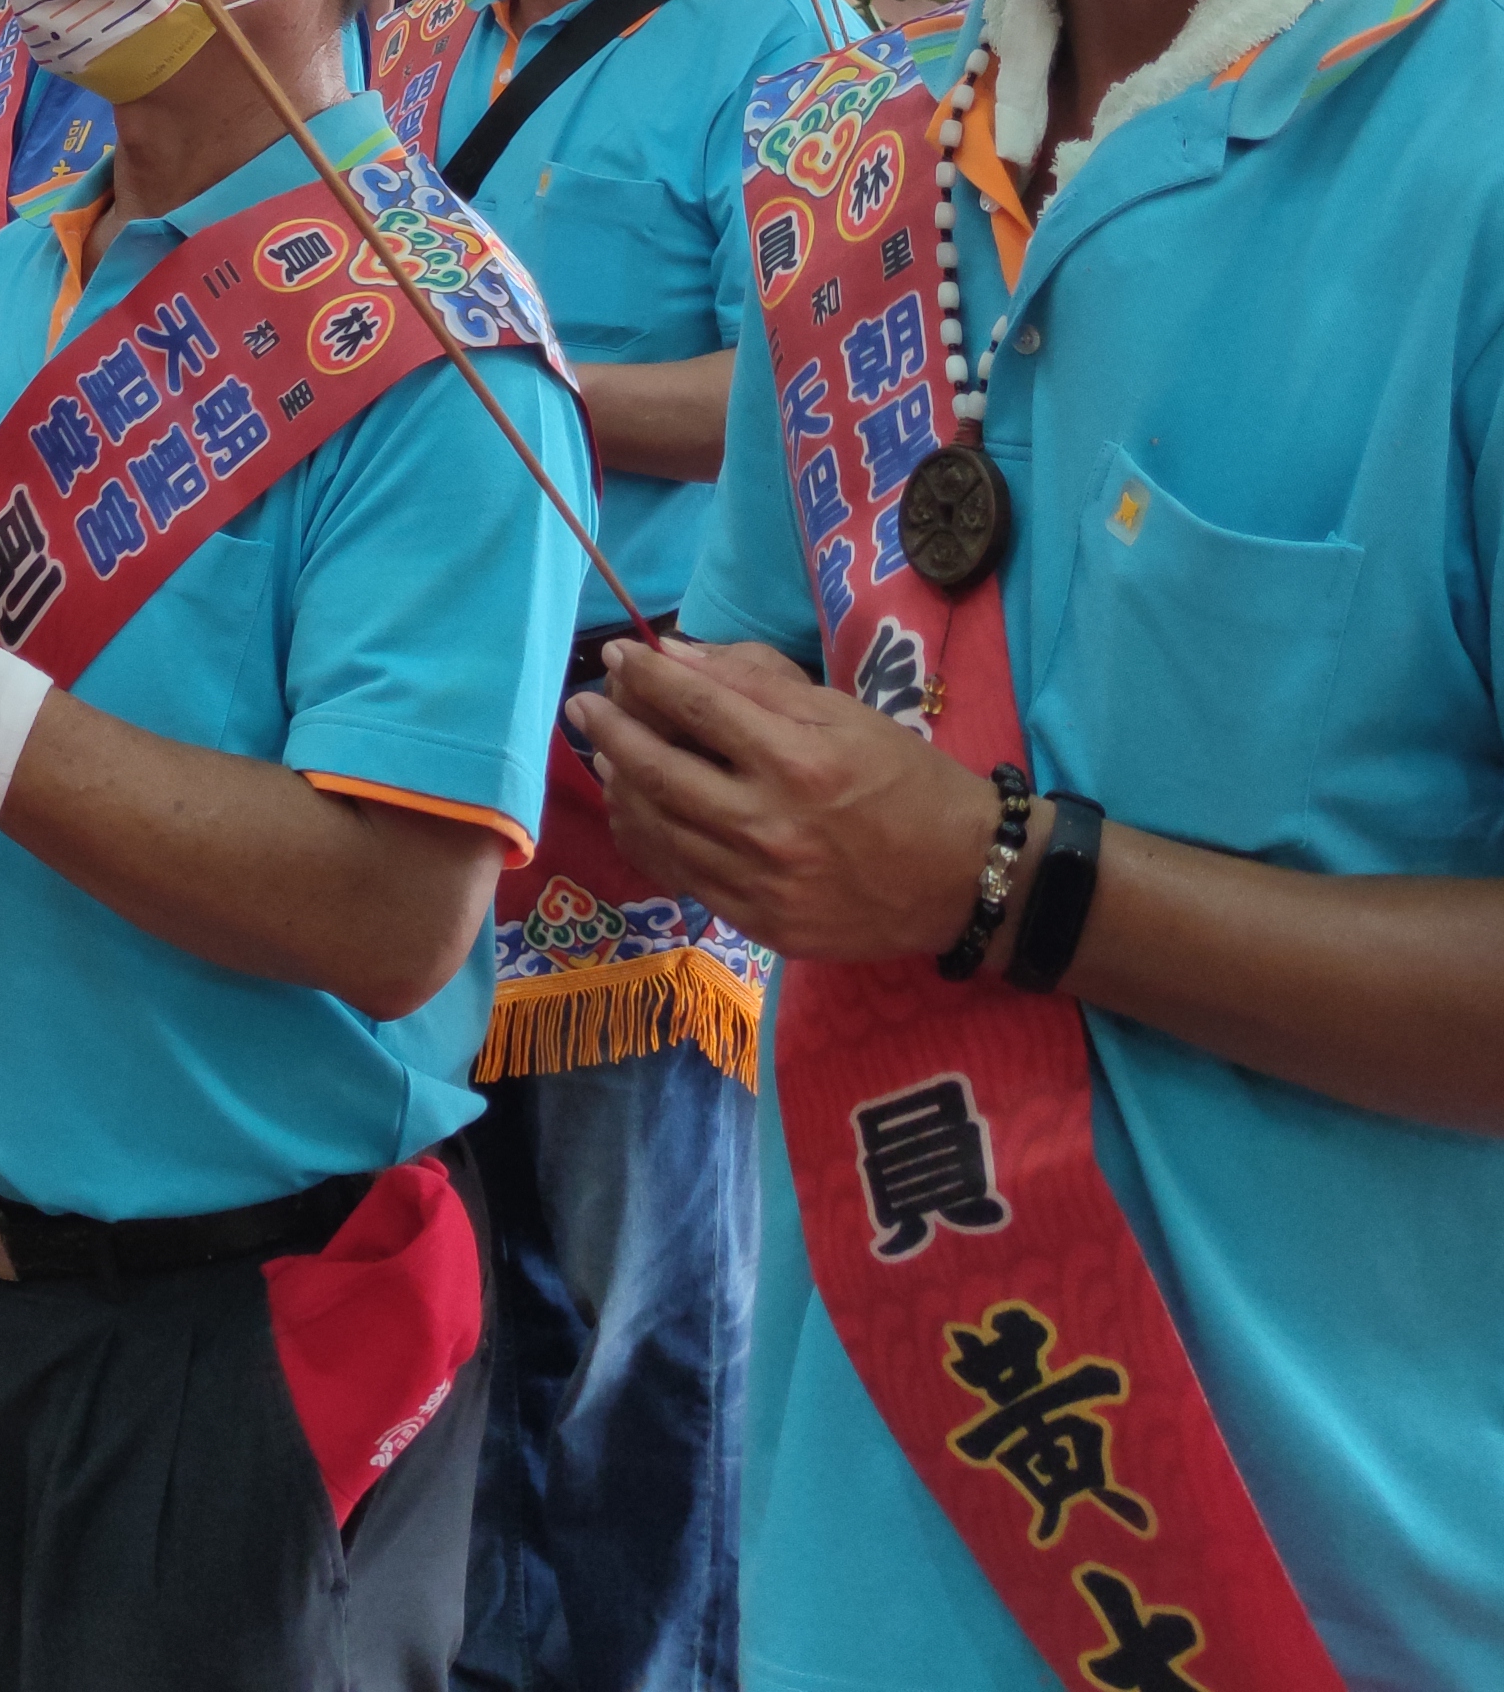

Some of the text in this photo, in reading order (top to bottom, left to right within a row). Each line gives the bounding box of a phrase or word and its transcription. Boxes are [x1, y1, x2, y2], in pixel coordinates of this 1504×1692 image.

[267, 227, 382, 362] 員林
[755, 149, 890, 293] 員林
[28, 292, 220, 499] 天聖堂
[202, 259, 316, 422] 三和里
[75, 374, 271, 581] 朝聖宮
[784, 359, 854, 644] 天聖堂
